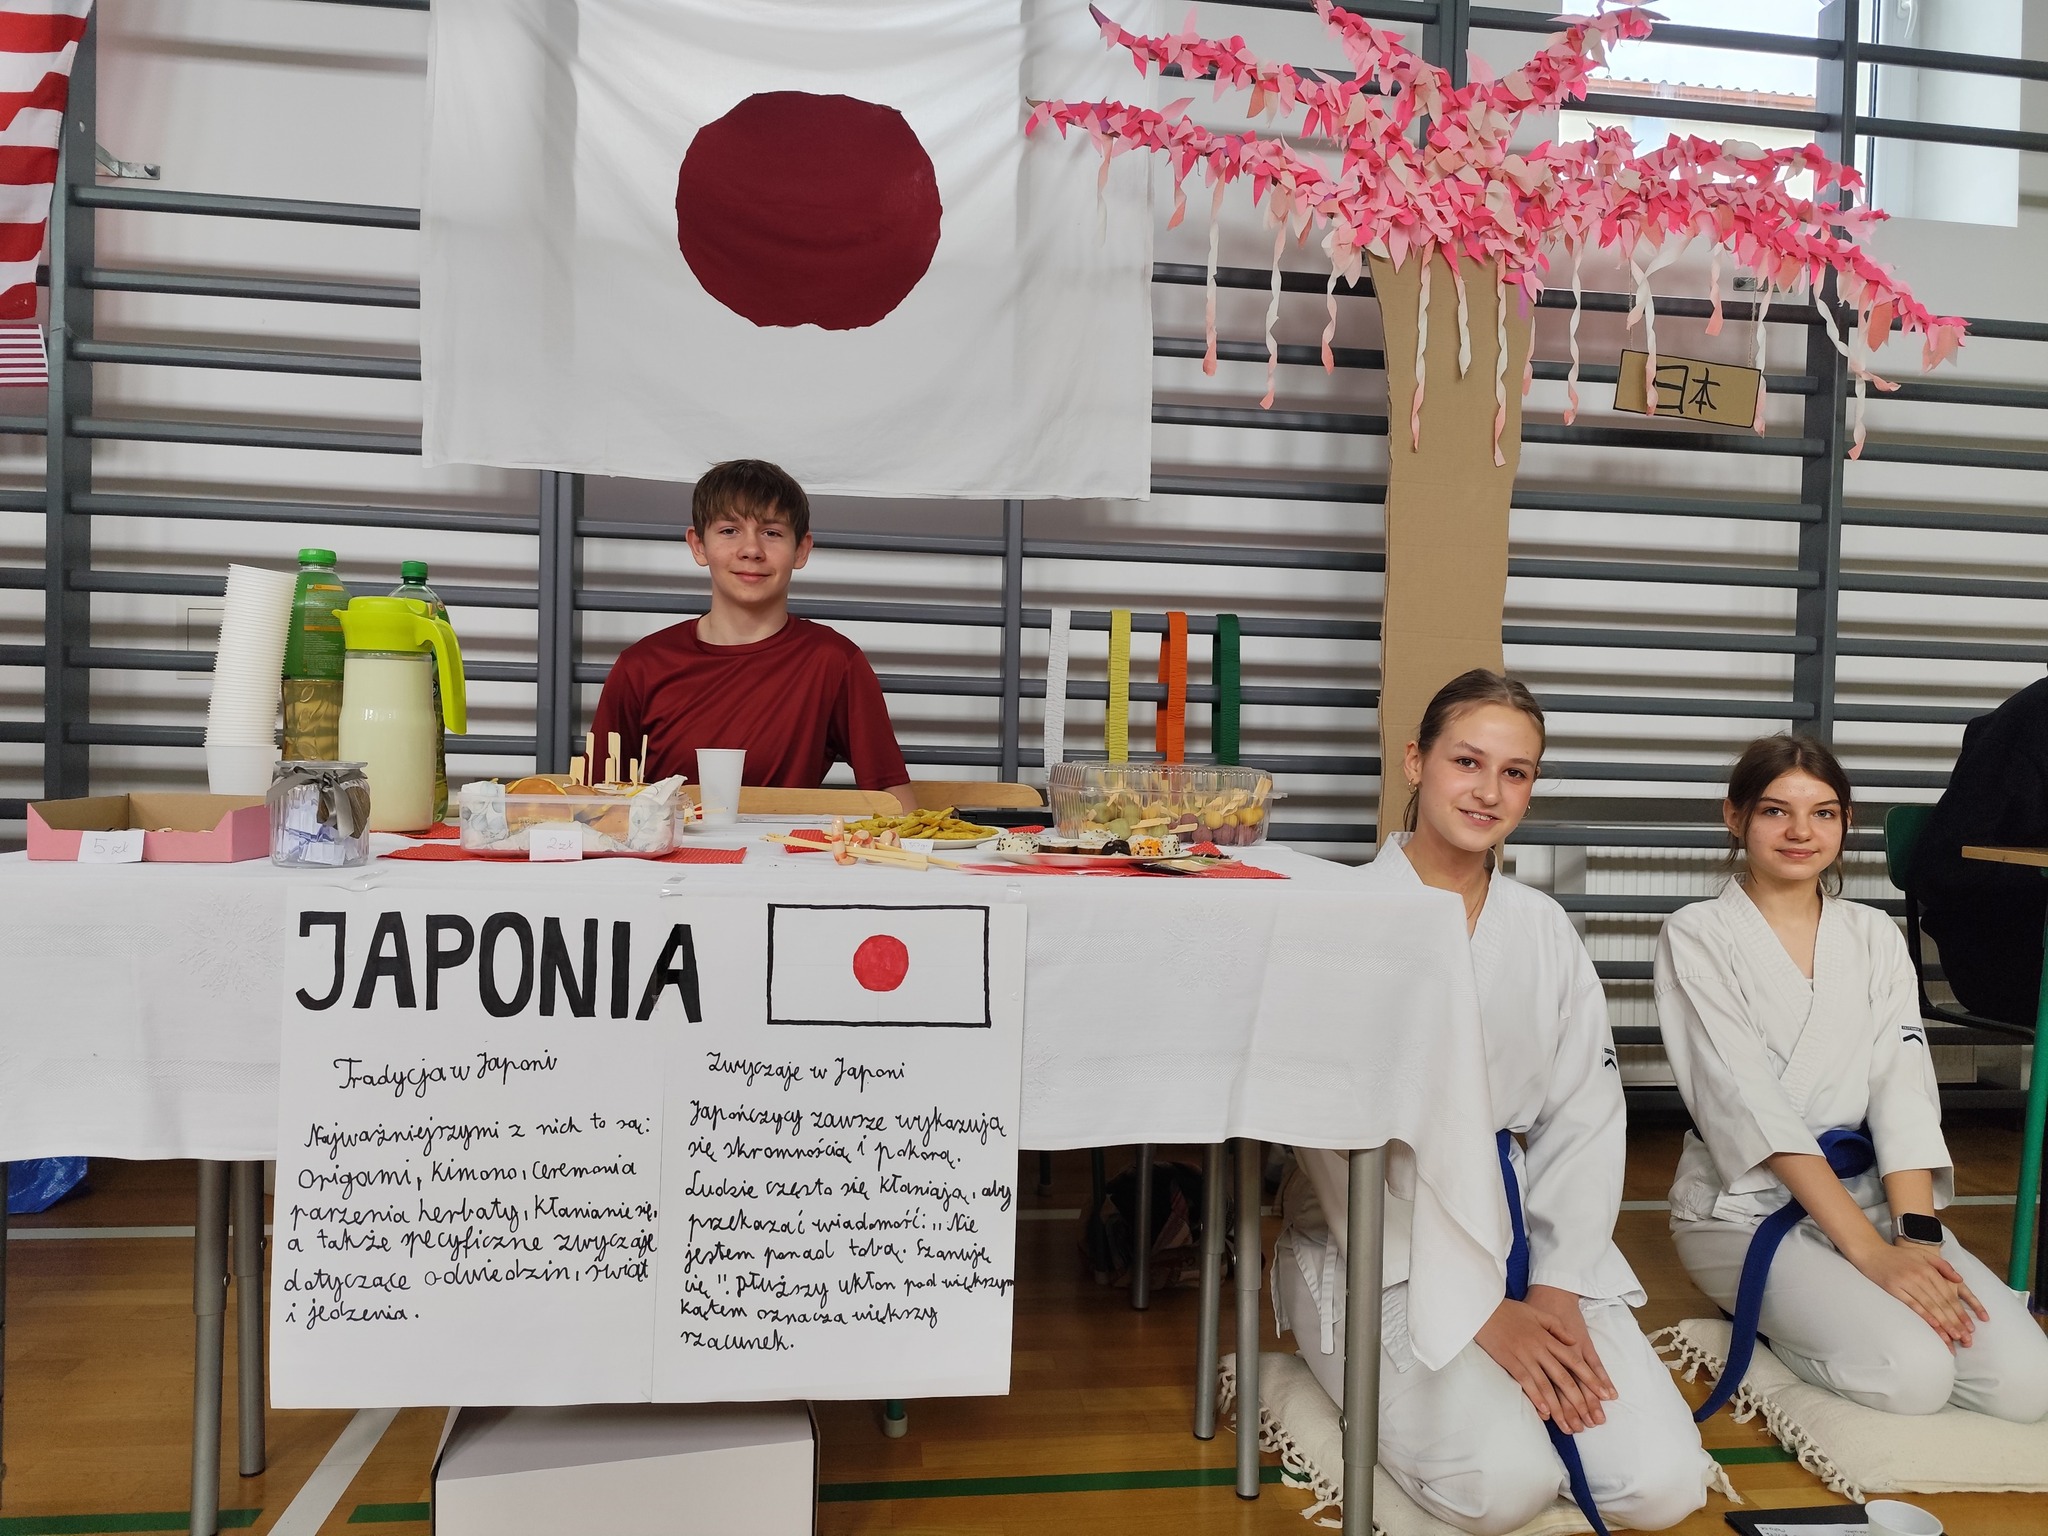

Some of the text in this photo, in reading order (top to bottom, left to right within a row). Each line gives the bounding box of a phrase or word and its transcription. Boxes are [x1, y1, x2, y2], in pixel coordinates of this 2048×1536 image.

[1651, 366, 1721, 415] 日本
[296, 911, 702, 1022] JAPONIA
[333, 1058, 447, 1098] Tradycja
[449, 1065, 471, 1082] w
[706, 1051, 905, 1094] Zwyczaje w Japoni
[304, 1112, 650, 1161] Najważniejszymi z nich to są:
[689, 1099, 1007, 1148] Japończycy zawsze wykazują
[687, 1134, 961, 1172] się skromnością i pokorą.
[685, 1169, 759, 1199] Ludzie
[765, 1177, 833, 1200] często
[840, 1176, 871, 1201] się
[981, 1179, 1012, 1213] aby
[290, 1204, 411, 1232] parzenia
[418, 1197, 529, 1234] herbaty,
[688, 1208, 806, 1243] przekazać
[287, 1225, 658, 1263] a także specyficzne zwyczaje
[683, 1237, 992, 1275] jestem ponad tobą. Szanuję
[283, 1268, 411, 1303] dotyczące
[903, 1272, 938, 1297] pod
[285, 1297, 420, 1331] i jedzenia.
[756, 1309, 849, 1326] oznacza
[851, 1302, 938, 1330] większy
